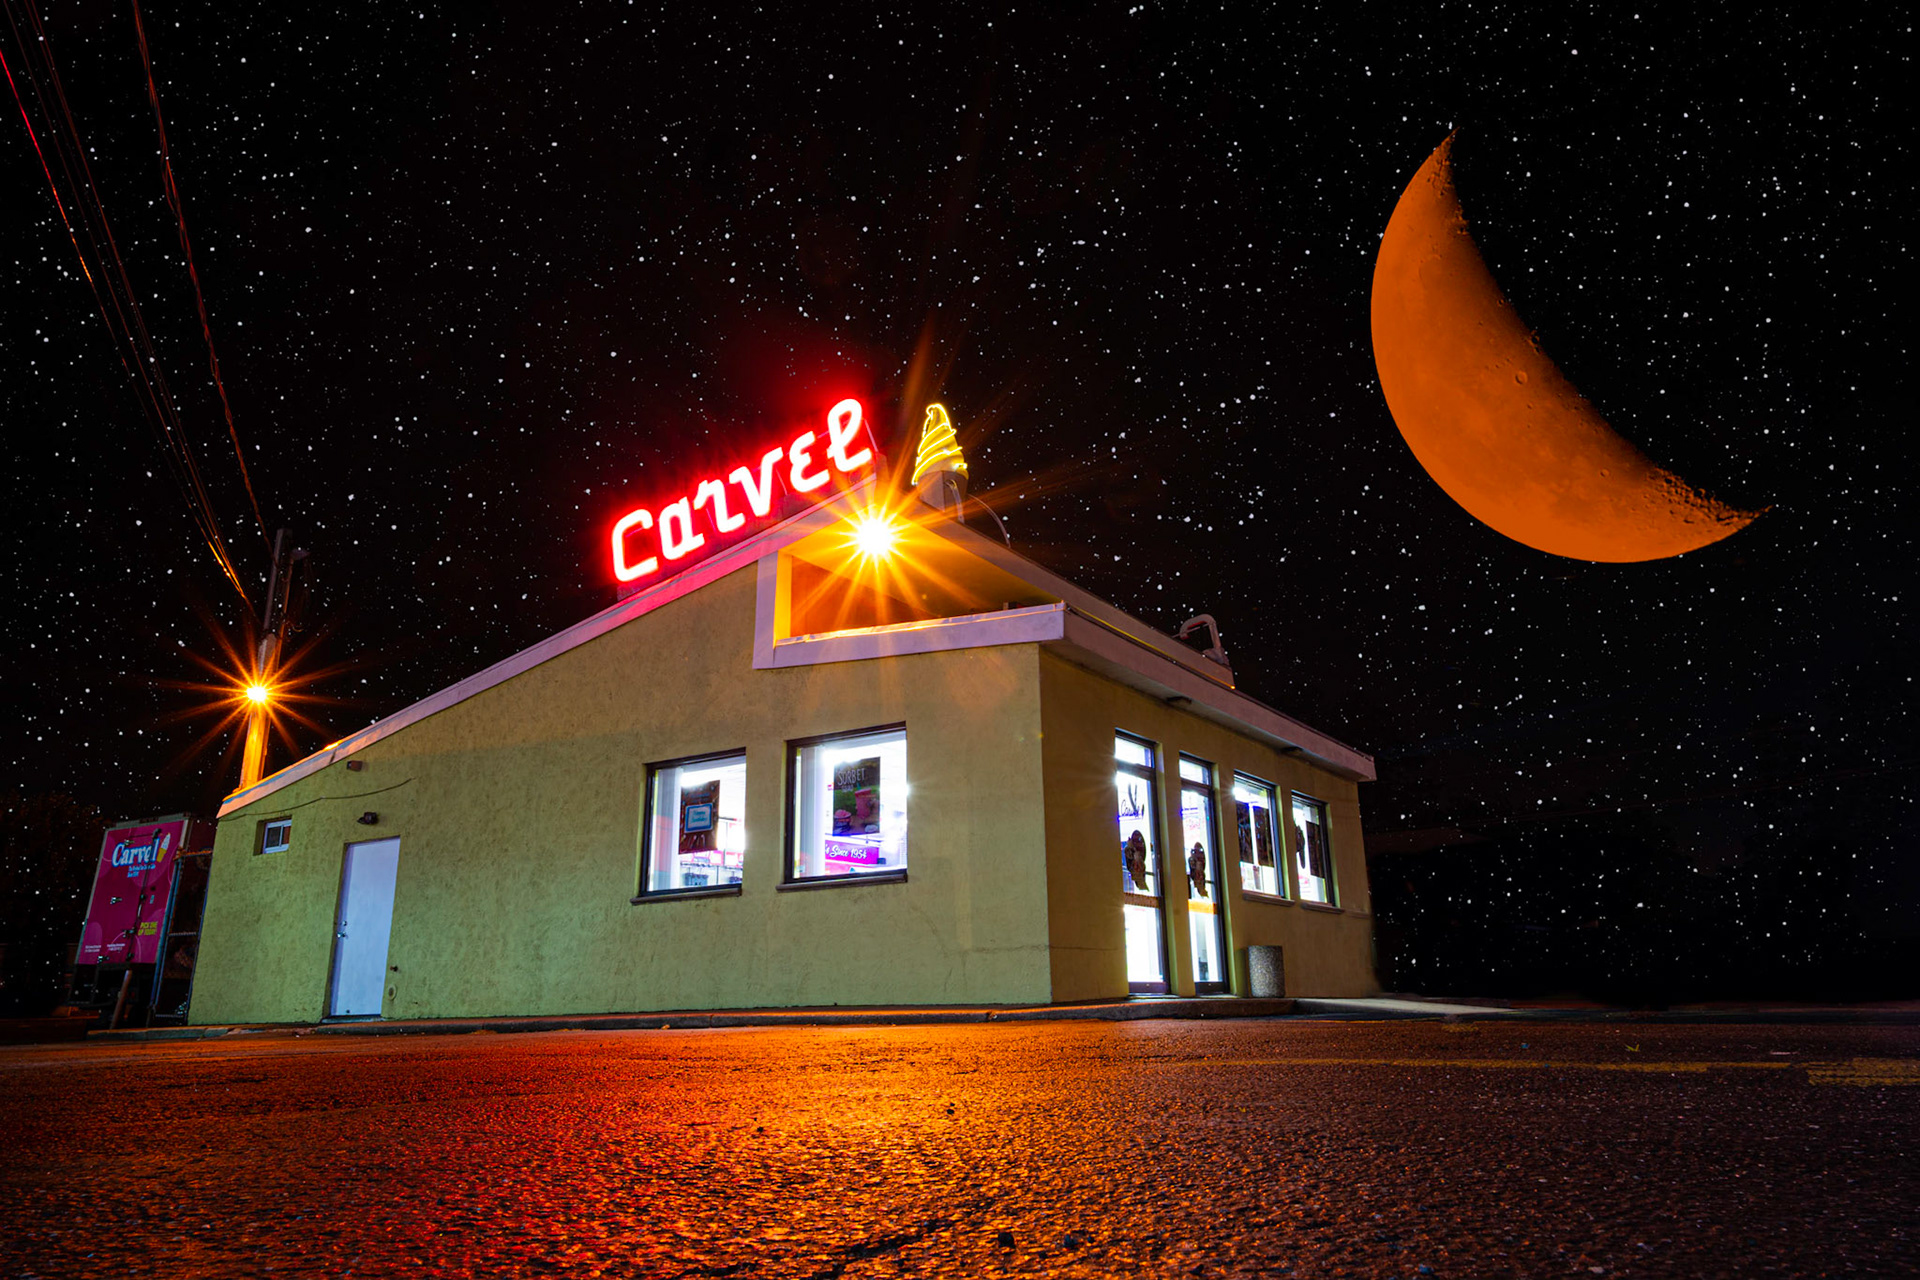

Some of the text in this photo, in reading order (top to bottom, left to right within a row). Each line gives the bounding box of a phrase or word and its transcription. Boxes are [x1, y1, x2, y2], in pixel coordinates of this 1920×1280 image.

[837, 768, 865, 786] SORBET
[111, 837, 160, 867] Carvel
[829, 845, 848, 858] Since
